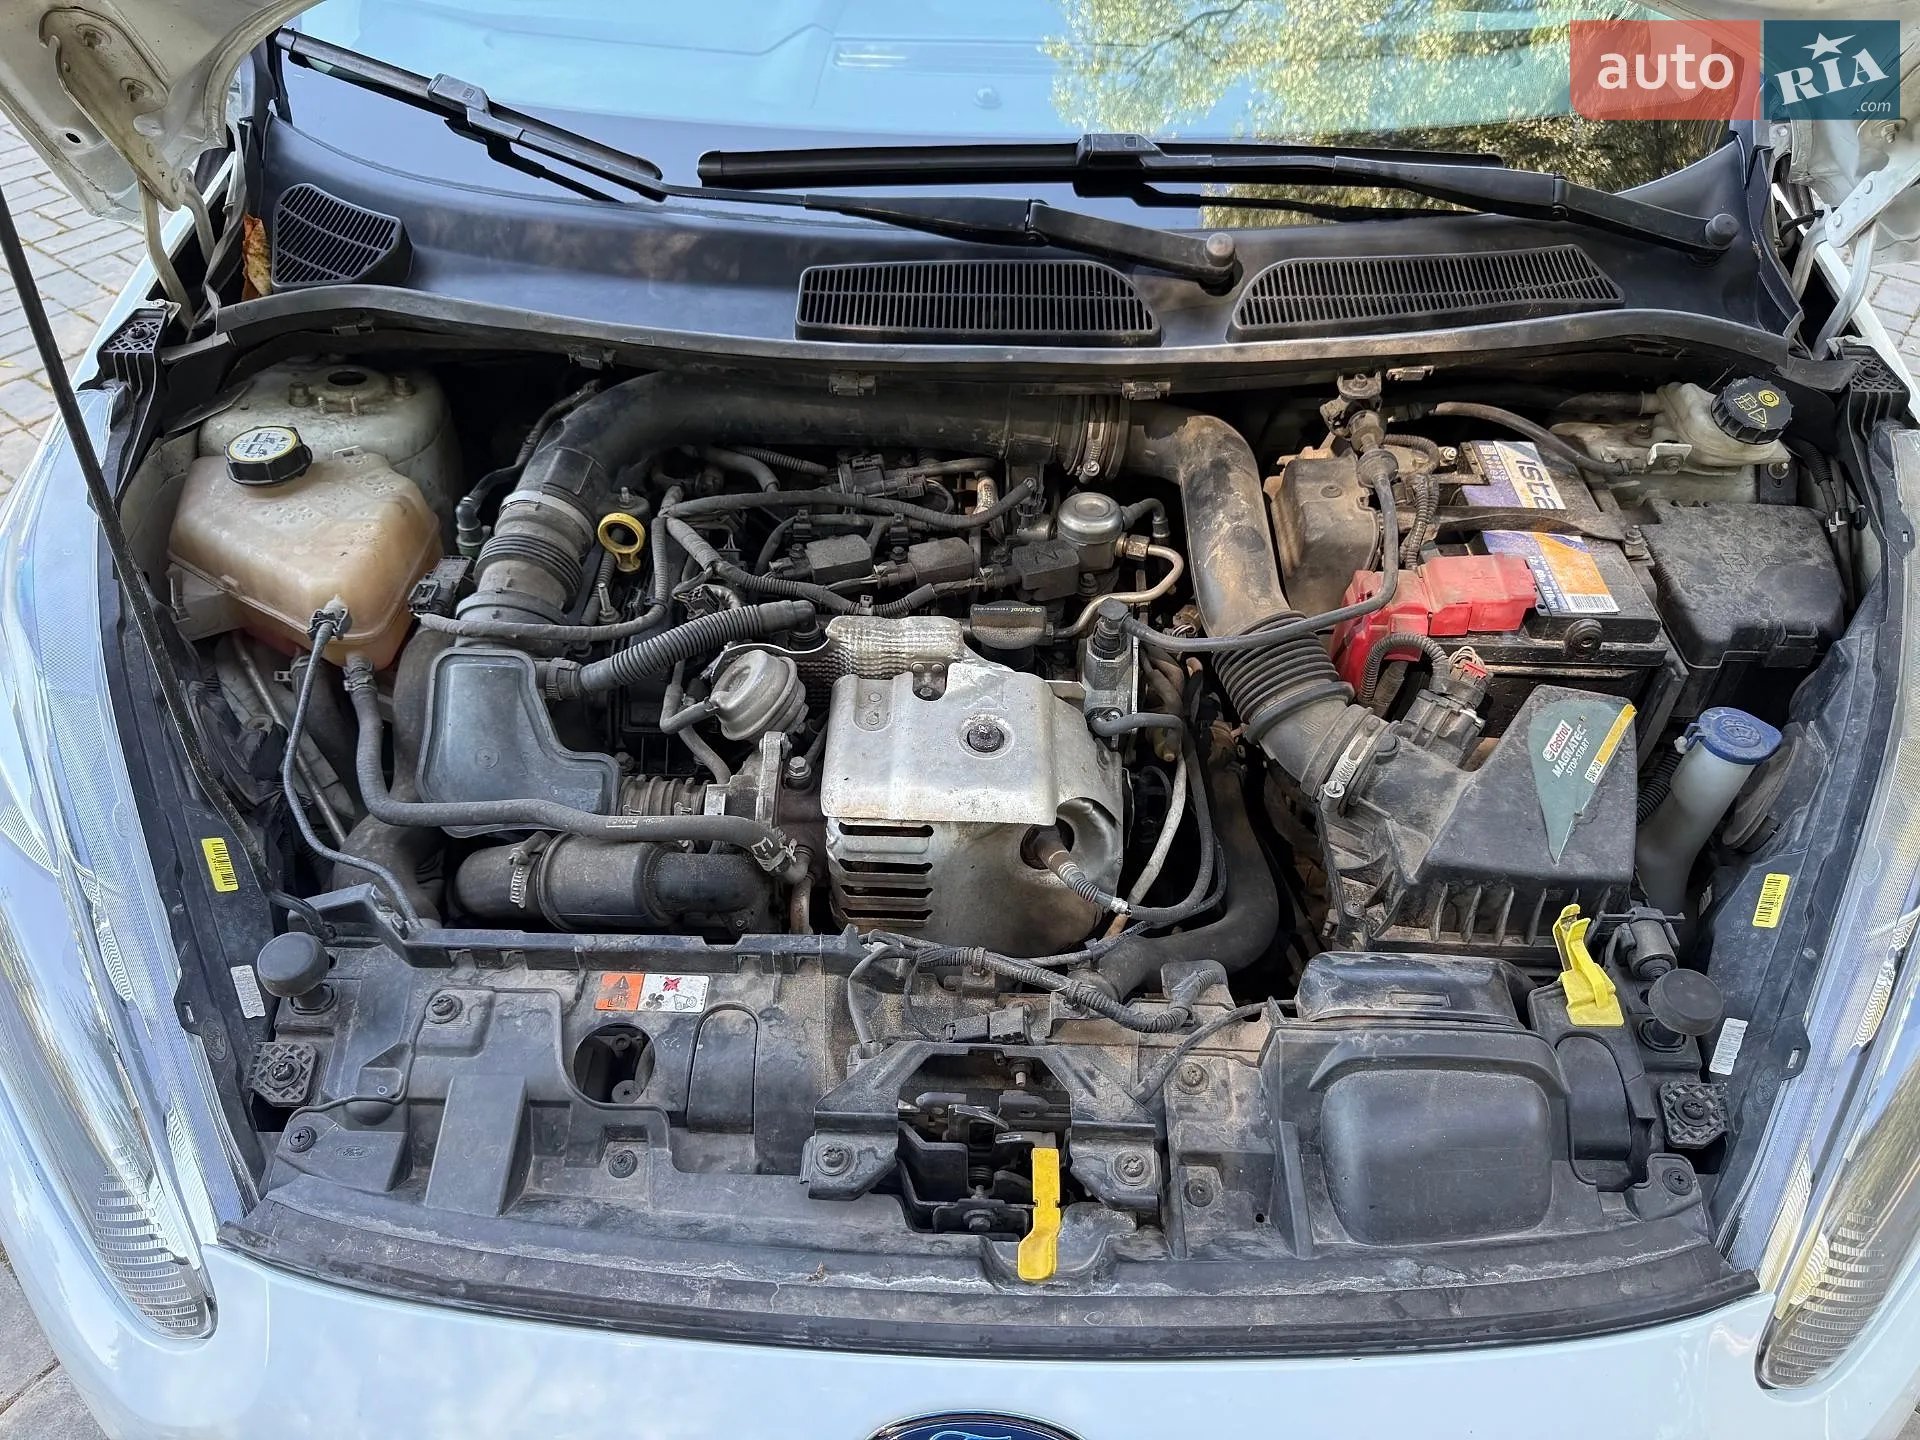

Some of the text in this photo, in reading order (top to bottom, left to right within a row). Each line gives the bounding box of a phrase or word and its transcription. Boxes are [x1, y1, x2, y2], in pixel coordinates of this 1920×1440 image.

[1550, 723, 1571, 753] Castrol
[1552, 724, 1586, 778] MAGNATEC
[1566, 738, 1590, 776] STOP-START
